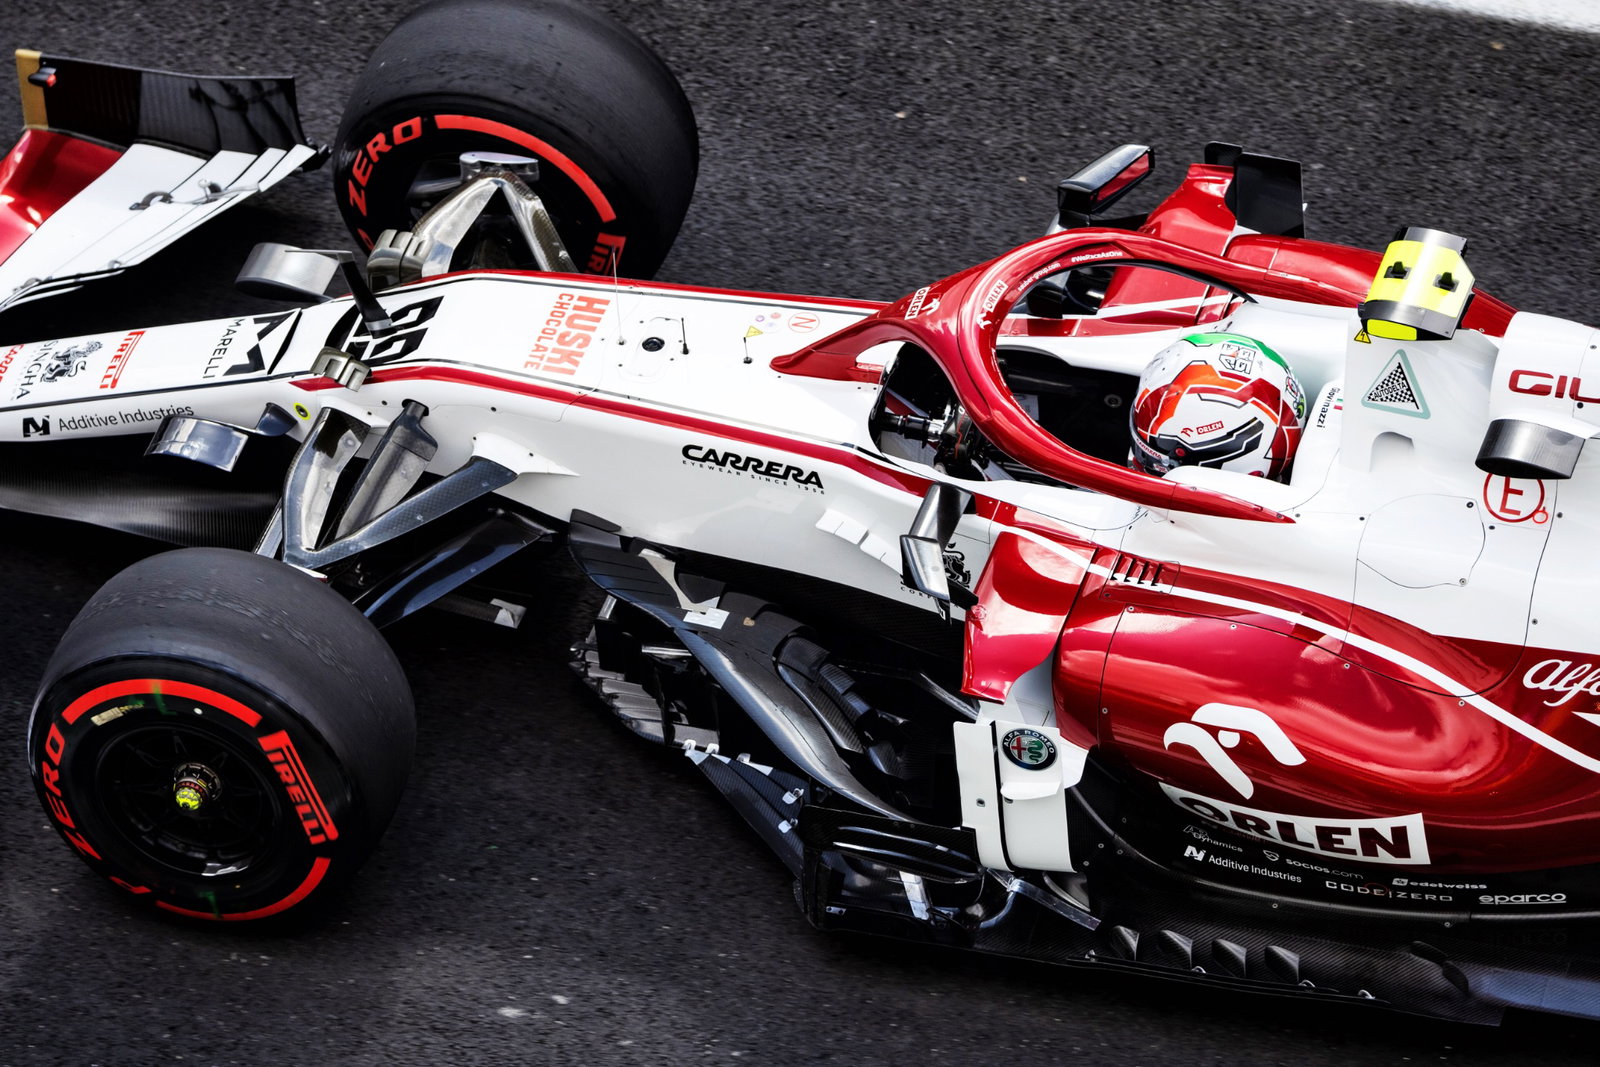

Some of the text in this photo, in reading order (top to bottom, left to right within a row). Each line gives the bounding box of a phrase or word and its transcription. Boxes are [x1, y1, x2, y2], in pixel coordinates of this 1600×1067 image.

[348, 116, 422, 217] ZERO
[907, 288, 927, 318] ORLEN
[986, 282, 1006, 310] ORLEN
[203, 318, 246, 379] MARELLI
[524, 293, 574, 369] CHOCOLATE
[542, 295, 611, 375] HUSKI
[16, 340, 59, 399] SINGHA
[100, 330, 147, 389] PIRELLI
[1316, 387, 1341, 428] Giovinazzi
[1373, 381, 1406, 399] AUTODELTA
[58, 405, 195, 431] Additive Industries
[1197, 422, 1222, 434] ORLEN
[682, 444, 824, 489] CARRERA
[682, 460, 741, 476] EYEWEAR
[750, 474, 788, 486] SINCE
[1003, 729, 1055, 754] ALFA ROMEO
[42, 722, 103, 860] ZERO
[257, 729, 339, 845] PIRELLI
[1178, 796, 1411, 859] ORLEN
[1208, 854, 1302, 883] Additive Industries
[1285, 858, 1364, 880] socios.com
[1410, 880, 1488, 890] edelweiss
[1478, 892, 1567, 905] sparco
